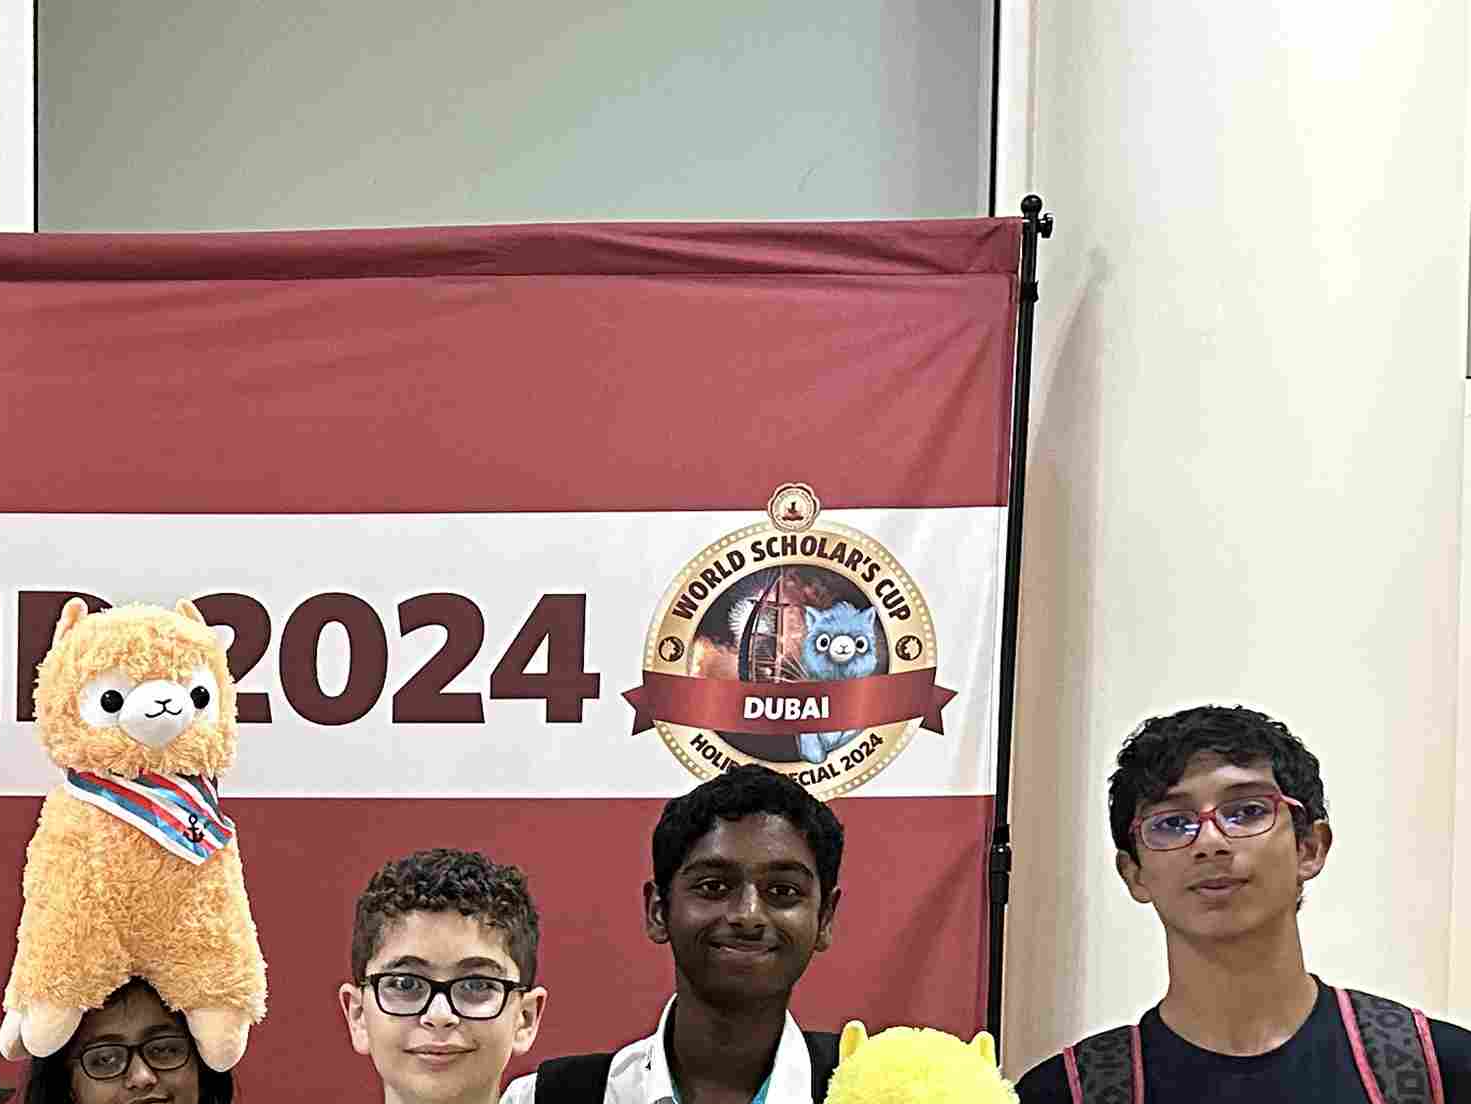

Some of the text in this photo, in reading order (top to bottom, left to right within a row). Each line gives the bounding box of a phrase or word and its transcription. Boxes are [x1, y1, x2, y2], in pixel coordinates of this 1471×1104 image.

[671, 534, 912, 622] WORLD SCHOLAR'S CUP
[191, 592, 601, 726] 2024
[743, 695, 830, 721] DUBAI
[689, 732, 884, 787] HOLI CIAL 2024
